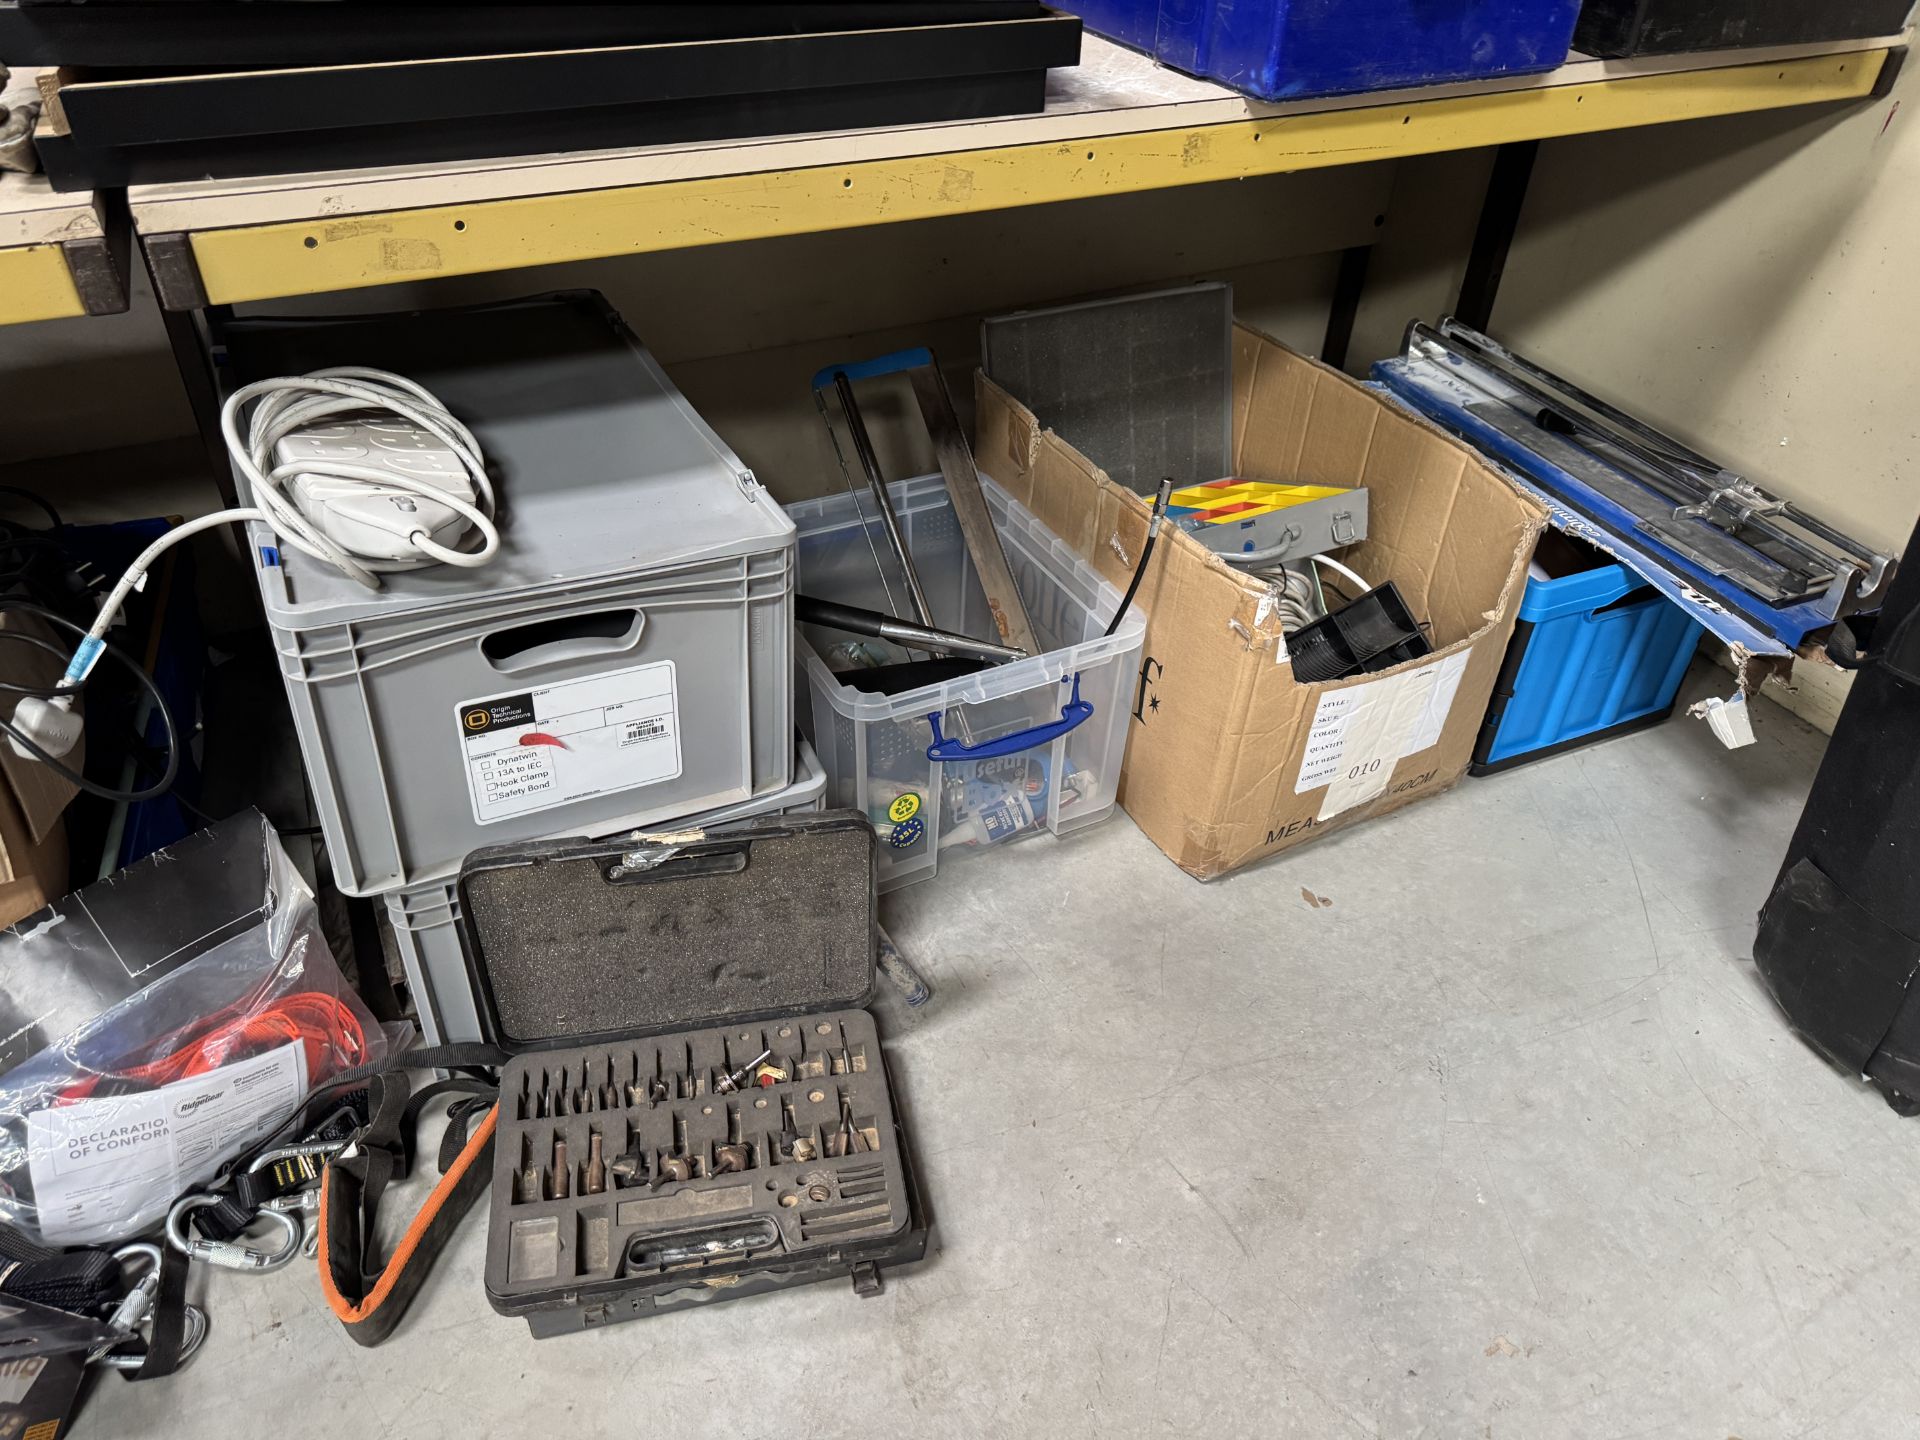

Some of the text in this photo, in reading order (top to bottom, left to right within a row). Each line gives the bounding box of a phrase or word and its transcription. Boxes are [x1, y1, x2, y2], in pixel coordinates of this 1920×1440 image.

[490, 705, 511, 714] Origin
[491, 708, 522, 719] Technical
[492, 712, 531, 724] Productions
[497, 751, 537, 766] Dynatwin
[497, 761, 543, 777] 13A to IEC
[1347, 758, 1381, 780] 010
[496, 771, 549, 789] Hook Clamp
[498, 780, 550, 799] Safety Bond
[898, 828, 915, 841] 35L
[180, 1090, 225, 1112] RidgeGear
[68, 1117, 168, 1149] DECLARATIO
[69, 1146, 92, 1160] OF
